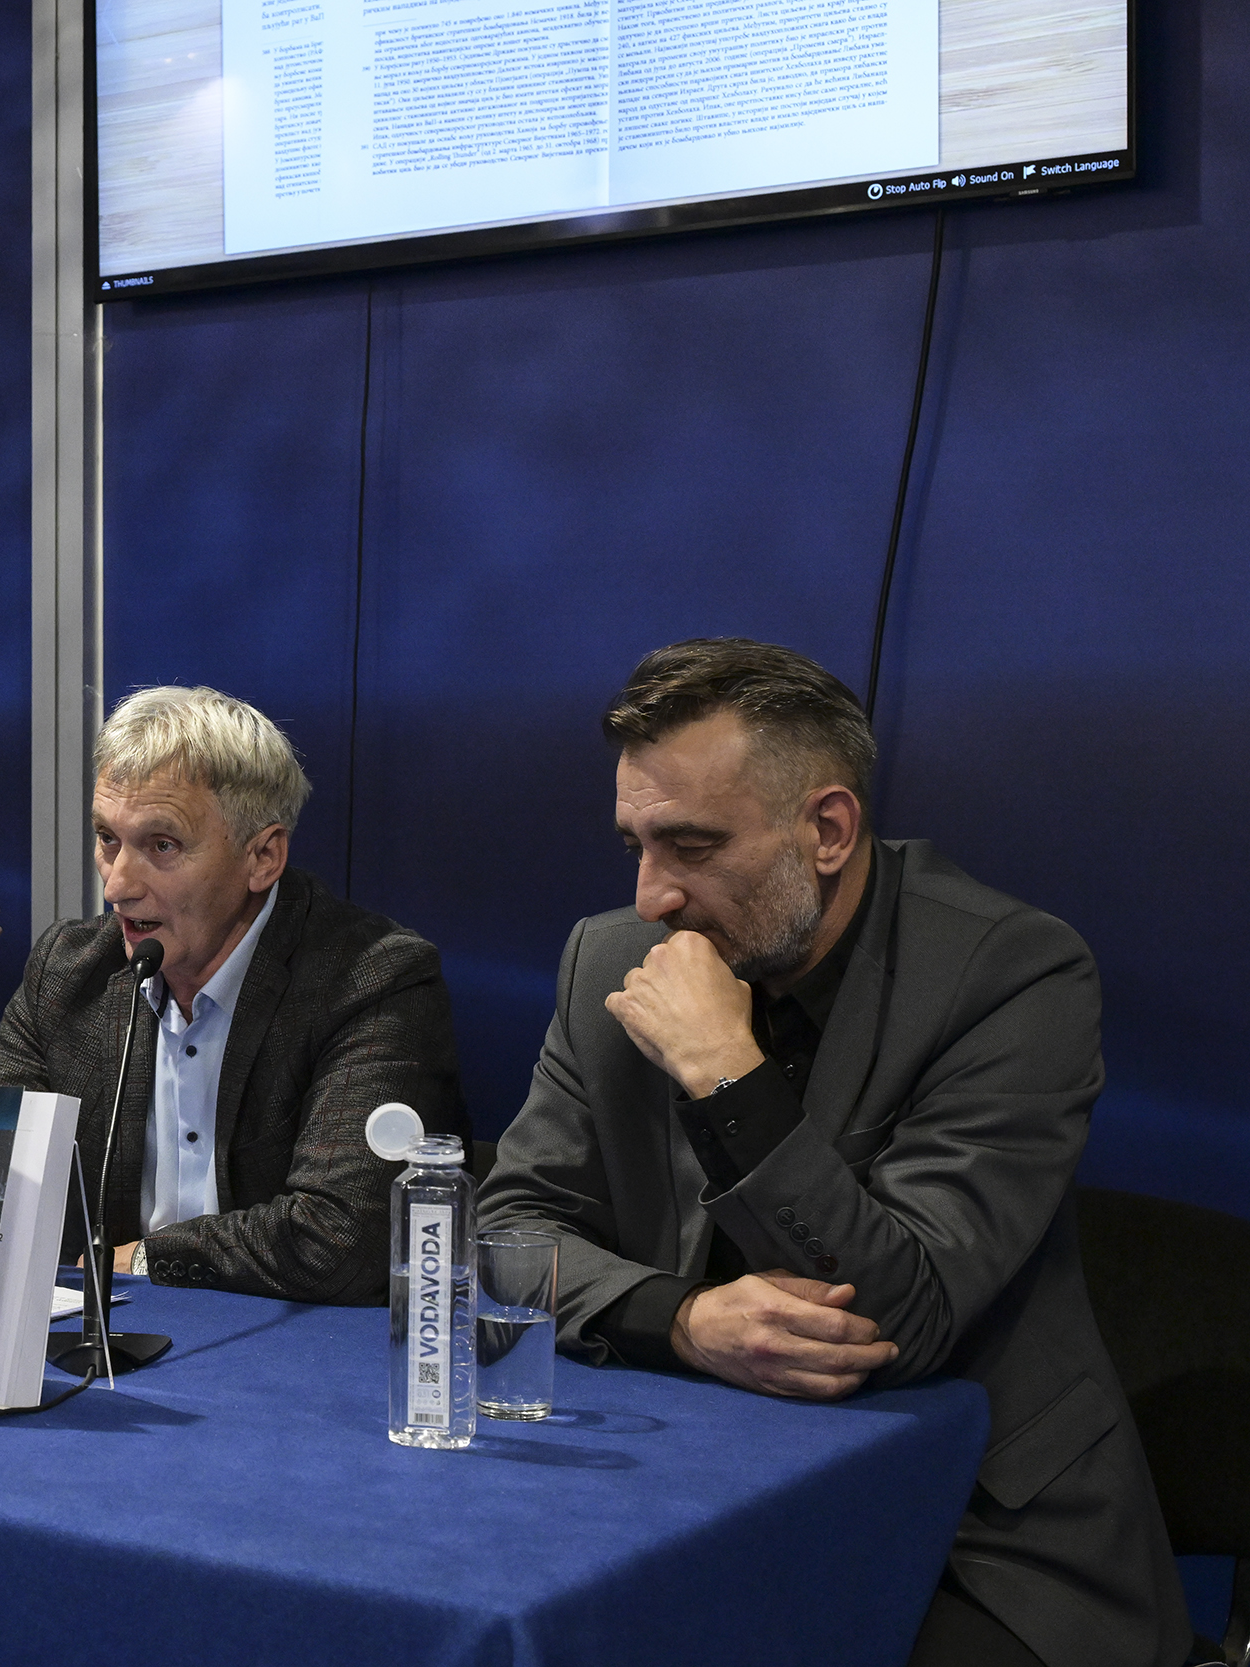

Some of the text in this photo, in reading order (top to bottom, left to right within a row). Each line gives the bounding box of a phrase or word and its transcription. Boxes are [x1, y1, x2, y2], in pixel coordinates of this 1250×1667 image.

[1041, 158, 1120, 176] Switch Language
[970, 170, 1014, 184] Sound On
[886, 178, 947, 195] Stop Auto Flip
[113, 276, 154, 288] THUMBNAILS
[420, 1222, 441, 1358] VODAVODA
